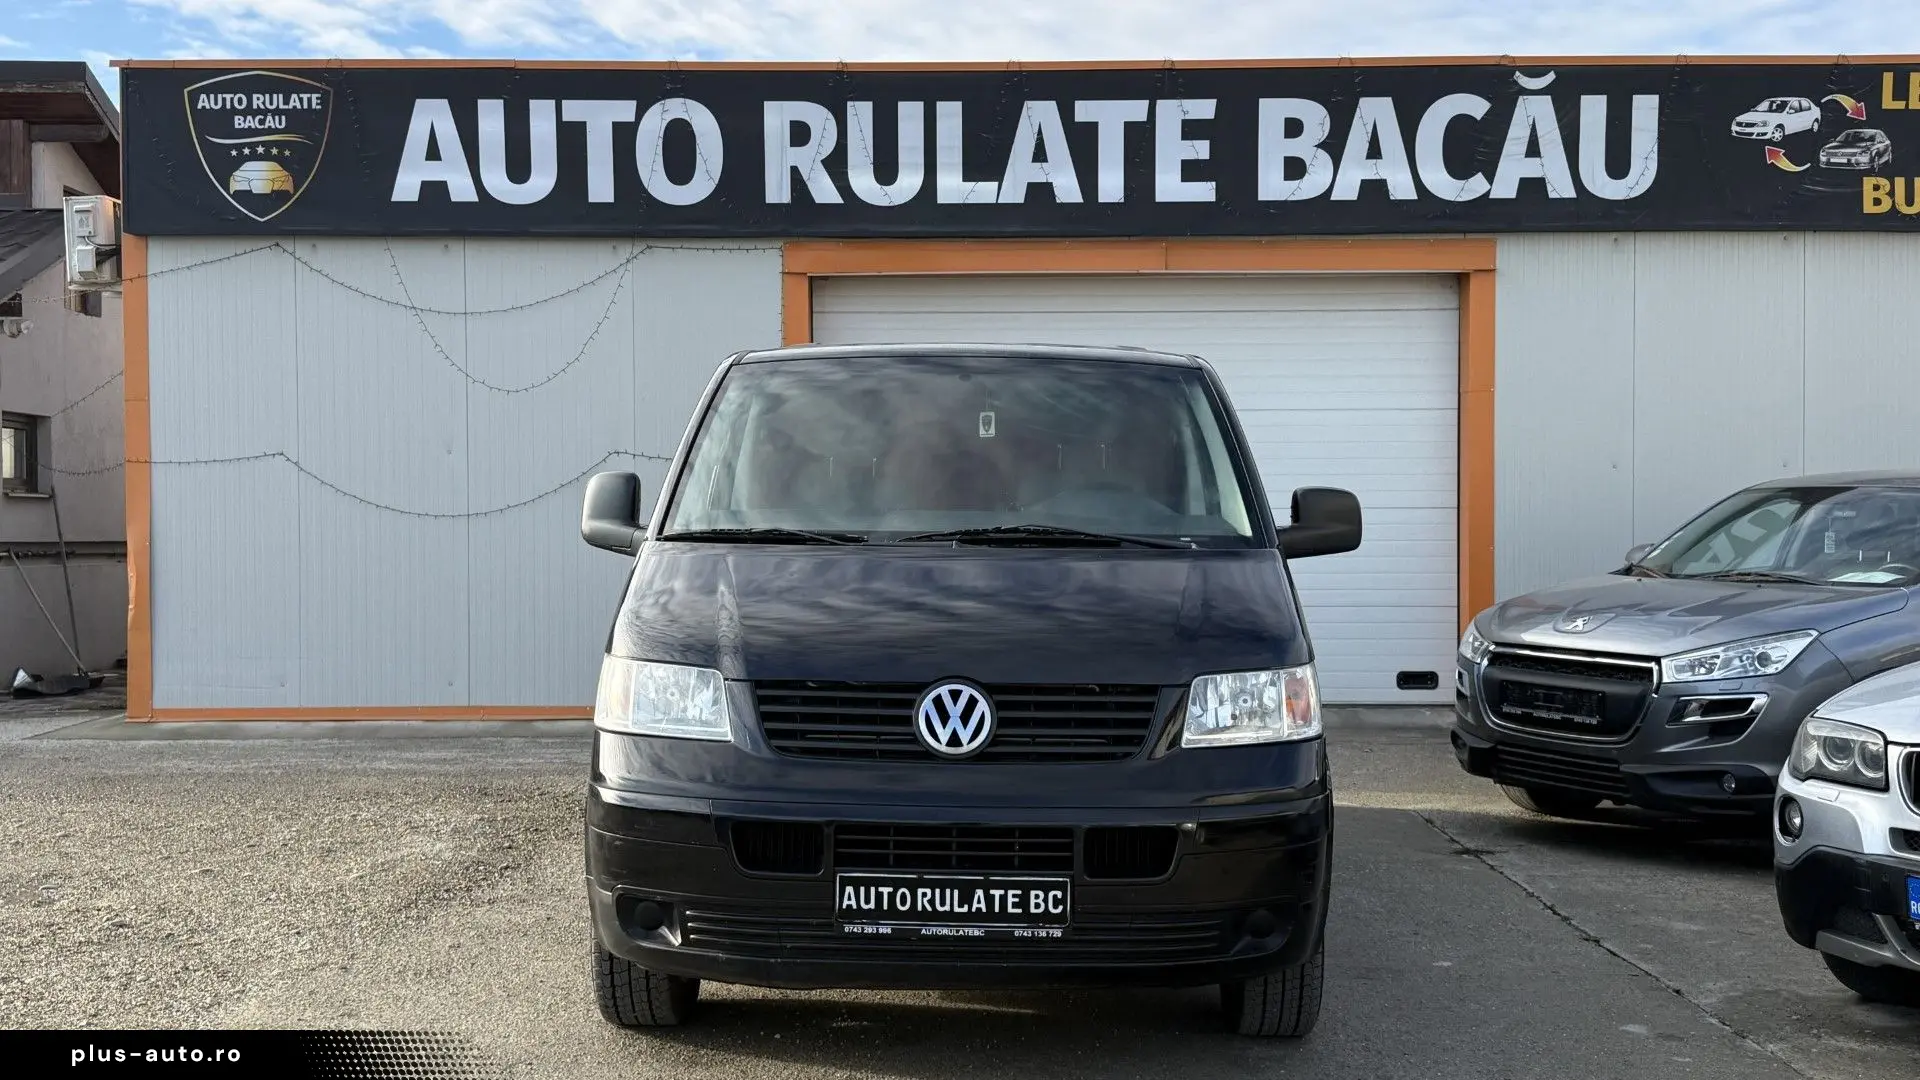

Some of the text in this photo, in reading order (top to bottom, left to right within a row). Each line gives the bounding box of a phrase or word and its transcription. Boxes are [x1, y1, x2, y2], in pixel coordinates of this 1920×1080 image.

[197, 93, 322, 110] AUTO RULATE
[234, 113, 286, 129] BACĂU
[391, 70, 1660, 206] AUTO RULATE BACĂU
[842, 886, 1064, 914] AUTO RULATE BC
[920, 927, 985, 936] AUTORULATEBC
